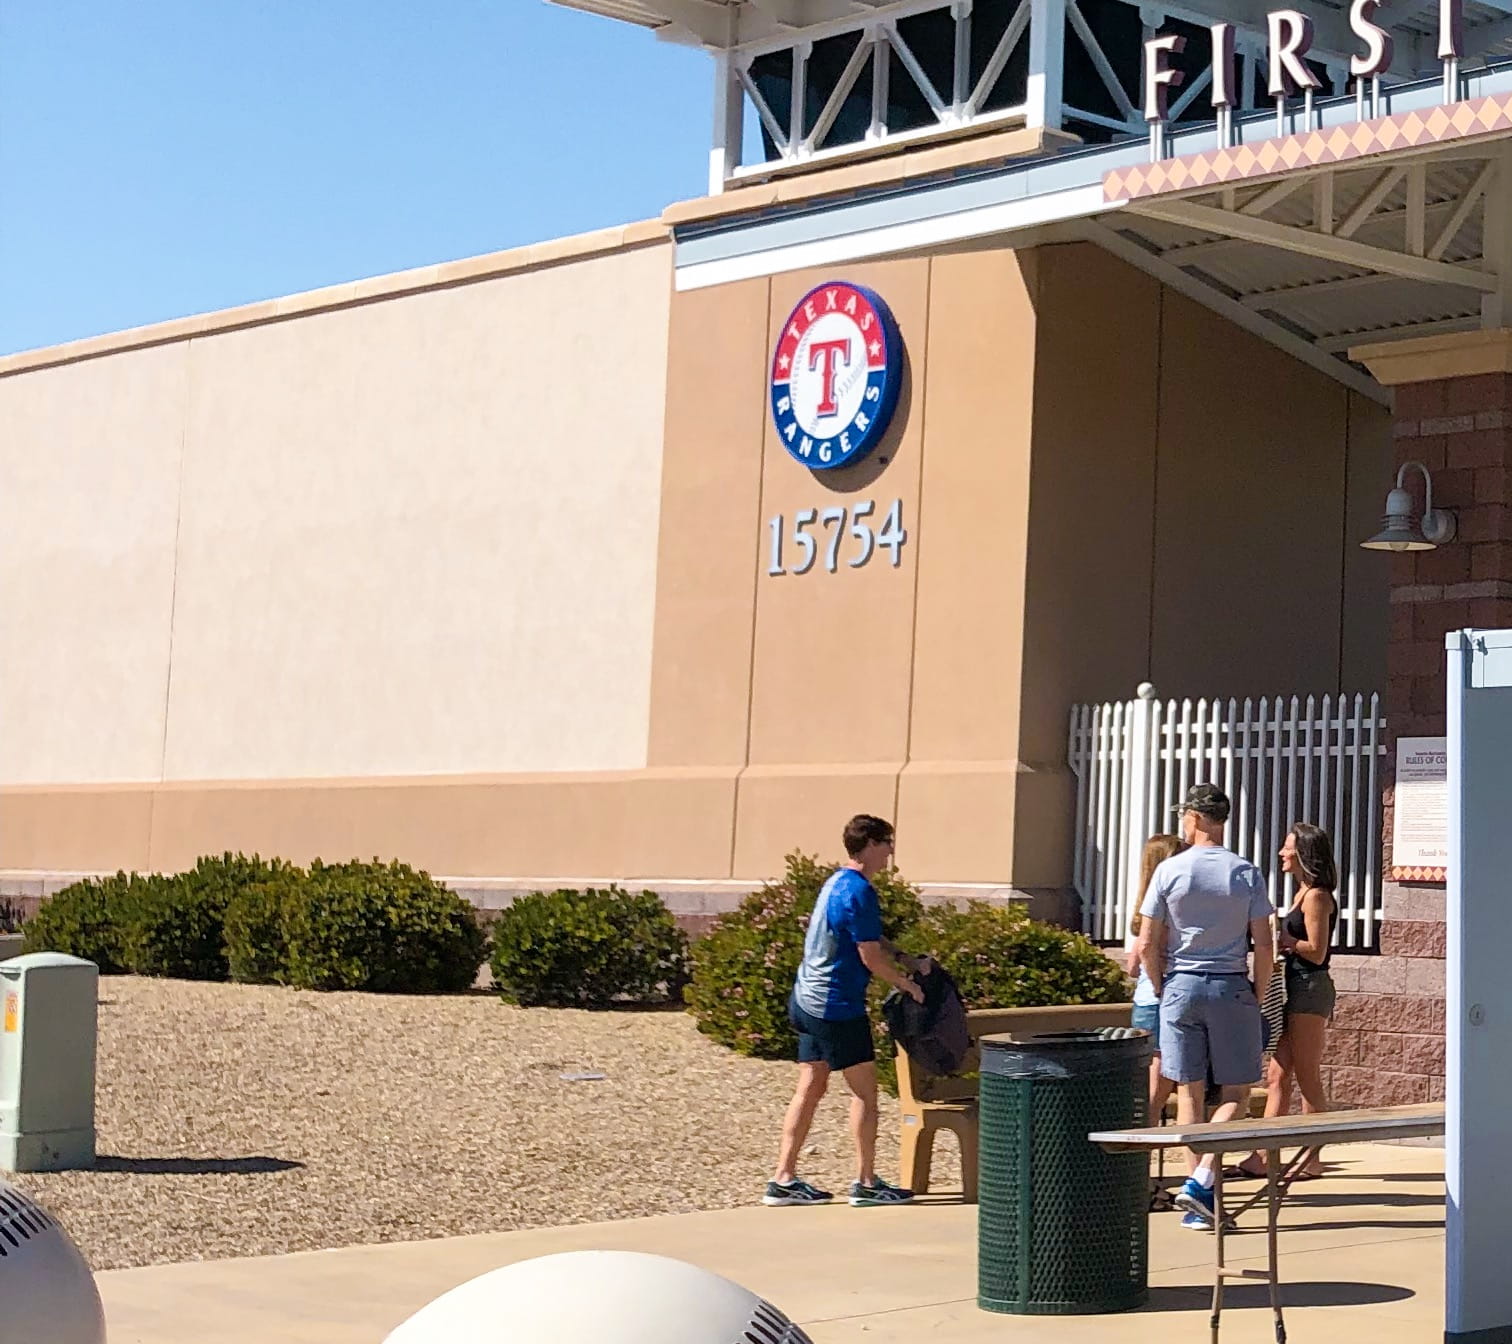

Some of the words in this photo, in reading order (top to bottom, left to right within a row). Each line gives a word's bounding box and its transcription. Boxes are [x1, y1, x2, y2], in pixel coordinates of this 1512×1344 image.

[786, 289, 874, 340] TEXAS
[808, 337, 852, 418] T
[776, 385, 880, 464] RANGERS
[767, 497, 908, 577] 15754
